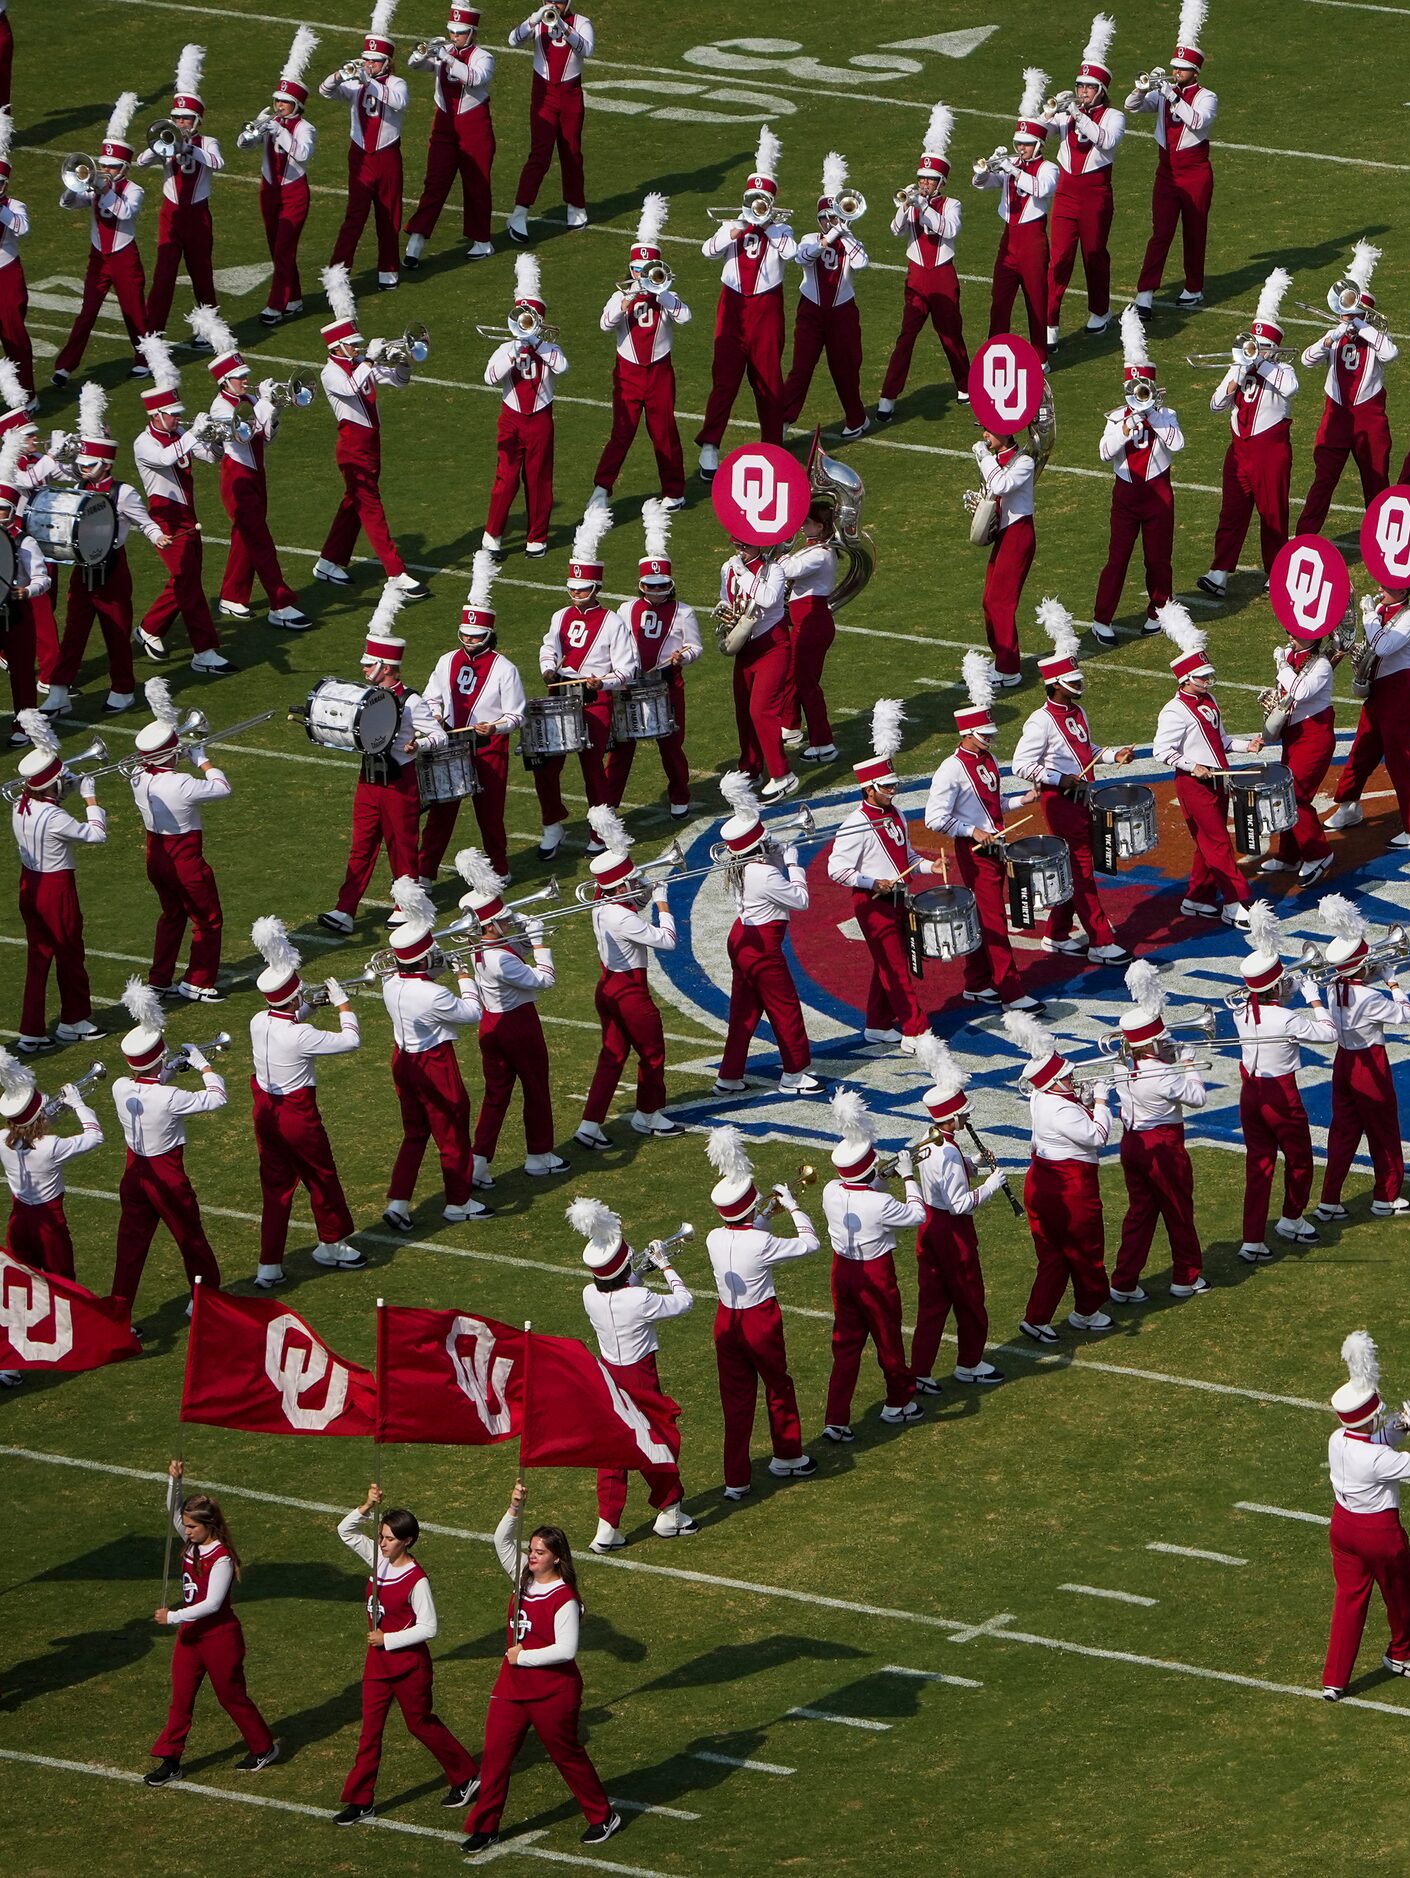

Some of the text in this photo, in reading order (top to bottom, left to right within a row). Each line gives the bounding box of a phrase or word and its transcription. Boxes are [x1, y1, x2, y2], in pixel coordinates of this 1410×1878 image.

[453, 10, 460, 22] OU
[369, 39, 377, 50] OU
[1177, 47, 1184, 58] OU
[1082, 65, 1089, 75] OU
[280, 80, 287, 91] OU
[177, 97, 185, 107] OU
[1019, 122, 1027, 133] OU
[106, 144, 113, 155] OU
[924, 158, 931, 168] OU
[754, 177, 762, 188] OU
[640, 248, 648, 259] OU
[743, 234, 760, 258] OU
[821, 247, 838, 270] OU
[634, 302, 653, 327] OU
[1255, 324, 1262, 334] OU
[234, 353, 243, 364] OU
[517, 353, 536, 380] OU
[1341, 344, 1359, 370] OU
[983, 344, 1027, 420] OU
[1242, 375, 1258, 402] OU
[80, 441, 87, 453] OU
[731, 454, 789, 533] OU
[574, 565, 582, 577] OU
[651, 562, 660, 573] OU
[1285, 545, 1332, 631] OU
[468, 612, 476, 623] OU
[640, 610, 662, 638] OU
[567, 621, 588, 647] OU
[1069, 657, 1078, 669] OU
[1200, 652, 1208, 663] OU
[456, 666, 478, 694] OU
[369, 693, 385, 706] YAMAHA
[1198, 705, 1218, 729] OU
[1066, 718, 1086, 743] OU
[424, 770, 432, 793] YAMAHA
[977, 763, 997, 791] OU
[1021, 901, 1030, 924] FIRTH
[911, 950, 919, 973] FIRTH
[0, 1251, 73, 1361] OU
[265, 1313, 349, 1430] OU
[446, 1315, 515, 1436] OU
